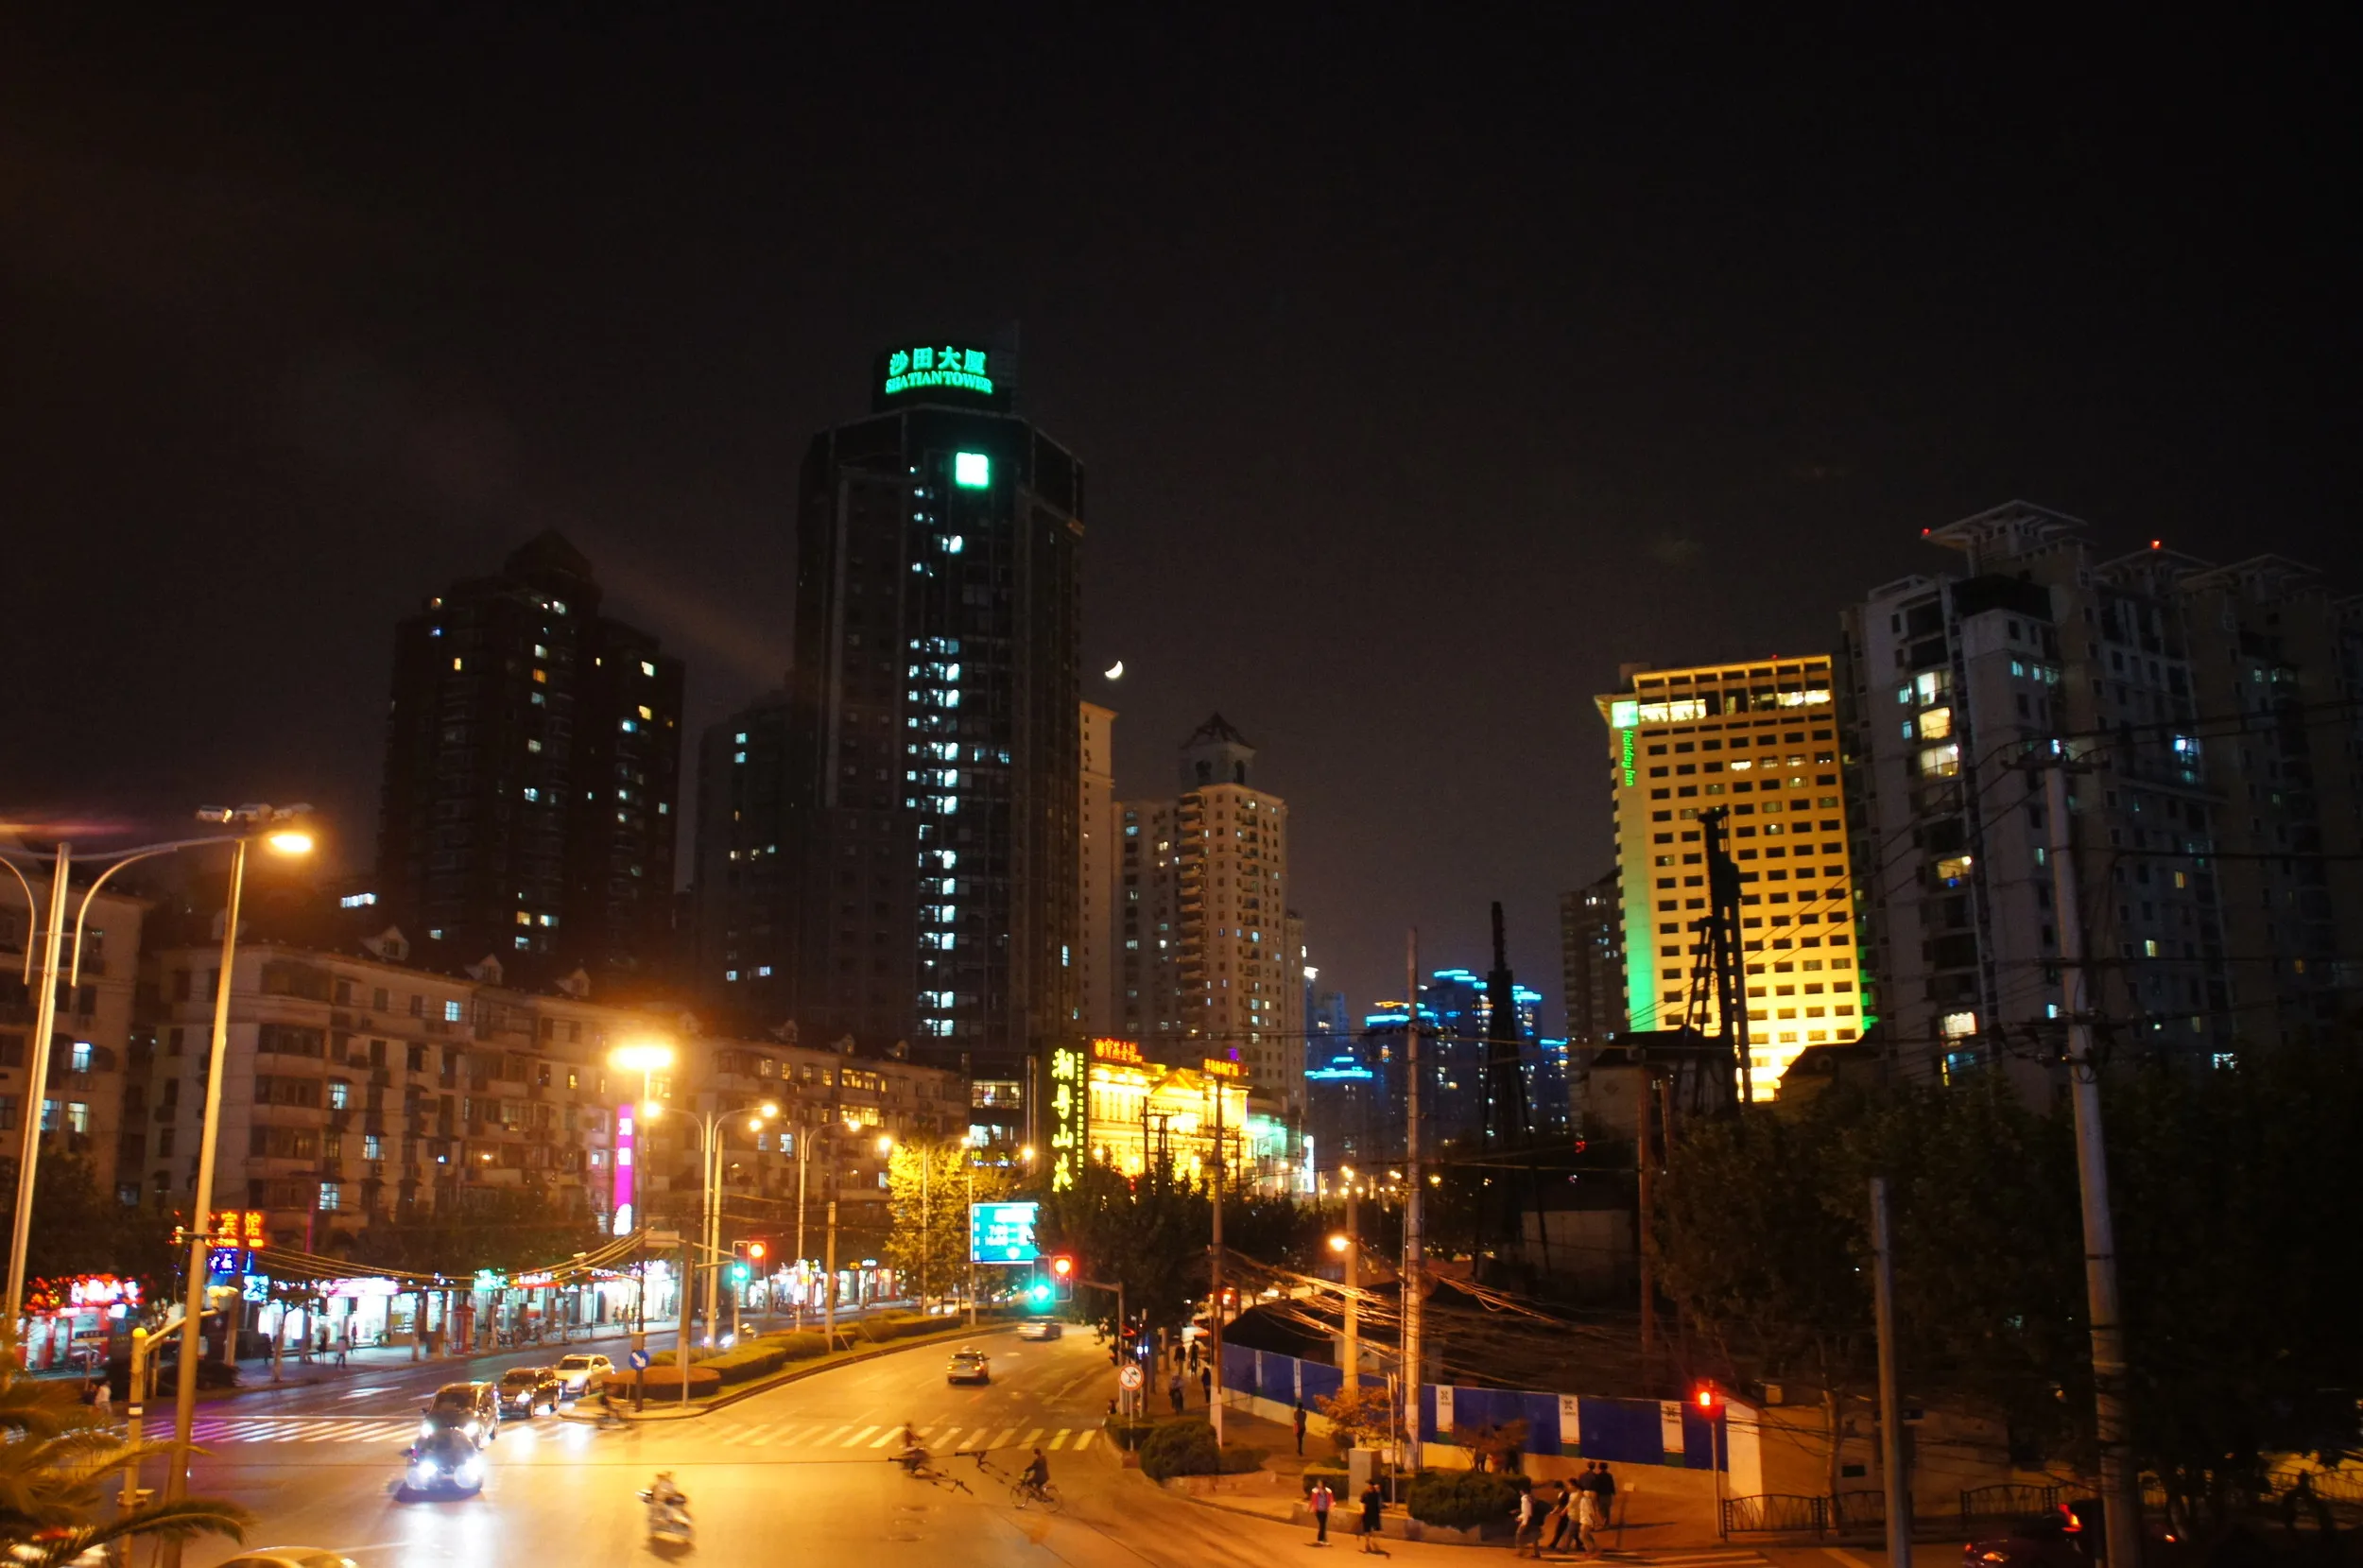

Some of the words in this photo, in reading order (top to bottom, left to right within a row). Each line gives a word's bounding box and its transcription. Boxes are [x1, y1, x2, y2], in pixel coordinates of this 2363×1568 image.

[943, 370, 992, 394] TOWER
[1621, 730, 1634, 768] Holiday
[1625, 769, 1636, 786] Inn
